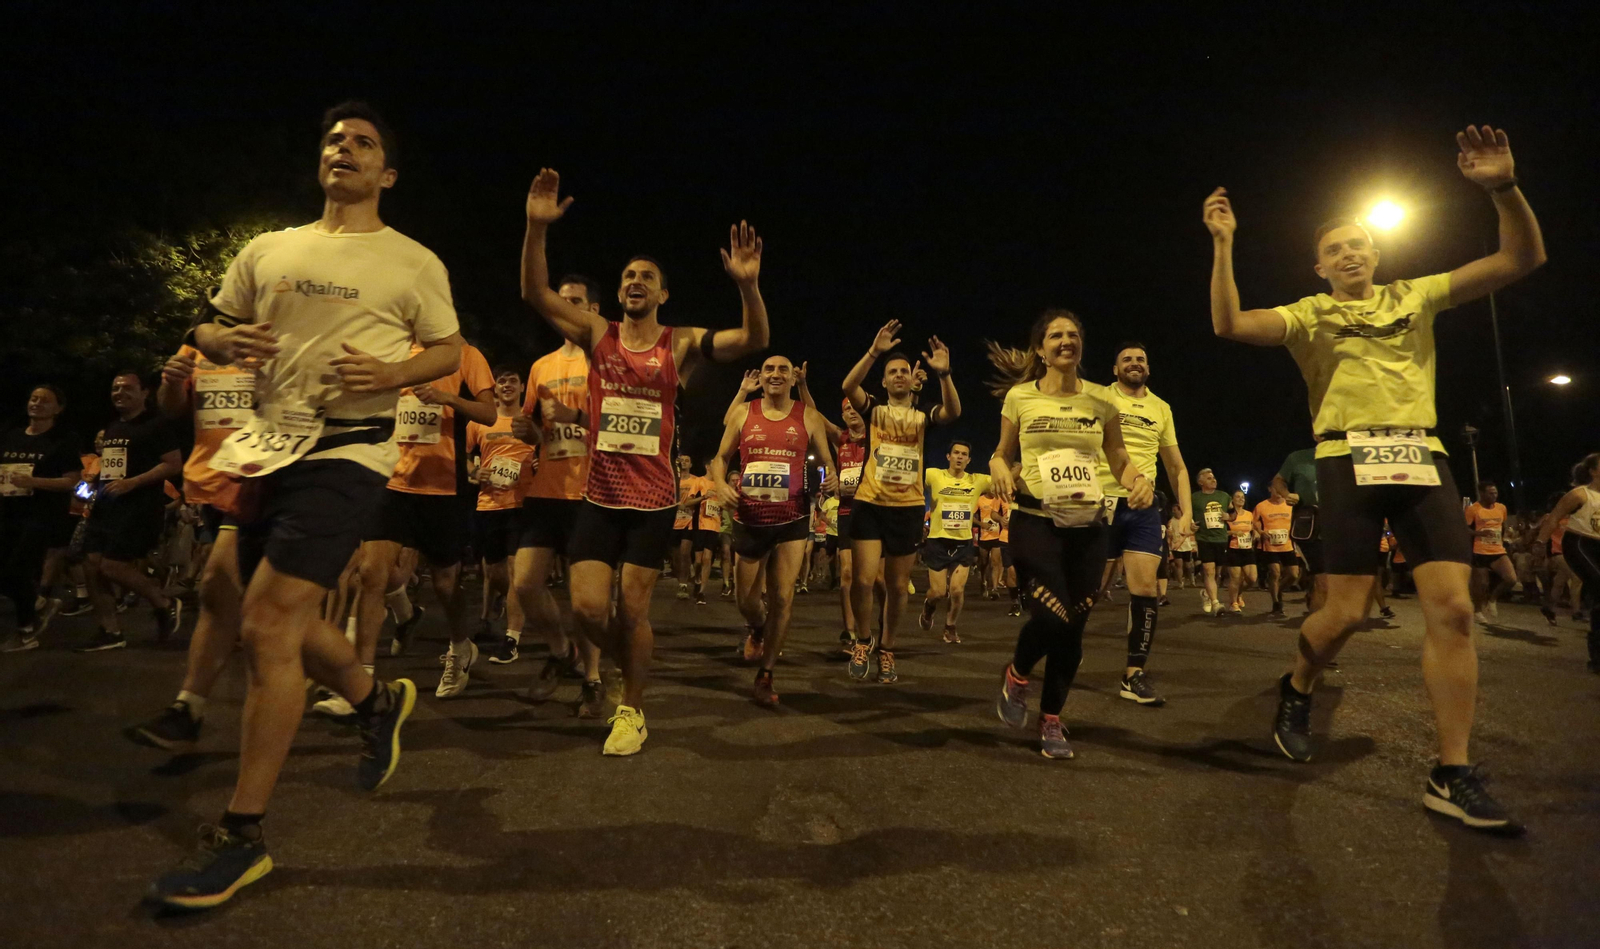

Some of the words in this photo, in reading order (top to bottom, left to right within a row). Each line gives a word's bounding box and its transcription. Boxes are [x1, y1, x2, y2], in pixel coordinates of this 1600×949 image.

[203, 391, 253, 409] 2638
[398, 411, 438, 426] 10982
[606, 415, 652, 435] 2867
[748, 446, 763, 455] Los
[764, 446, 797, 458] Lentos
[1362, 446, 1422, 464] 2520
[882, 456, 914, 471] 2246
[492, 466, 519, 481] 14340
[748, 474, 783, 488] 1112
[1050, 466, 1091, 483] 8406
[948, 511, 965, 520] 468
[1139, 606, 1157, 652] Kalenji
